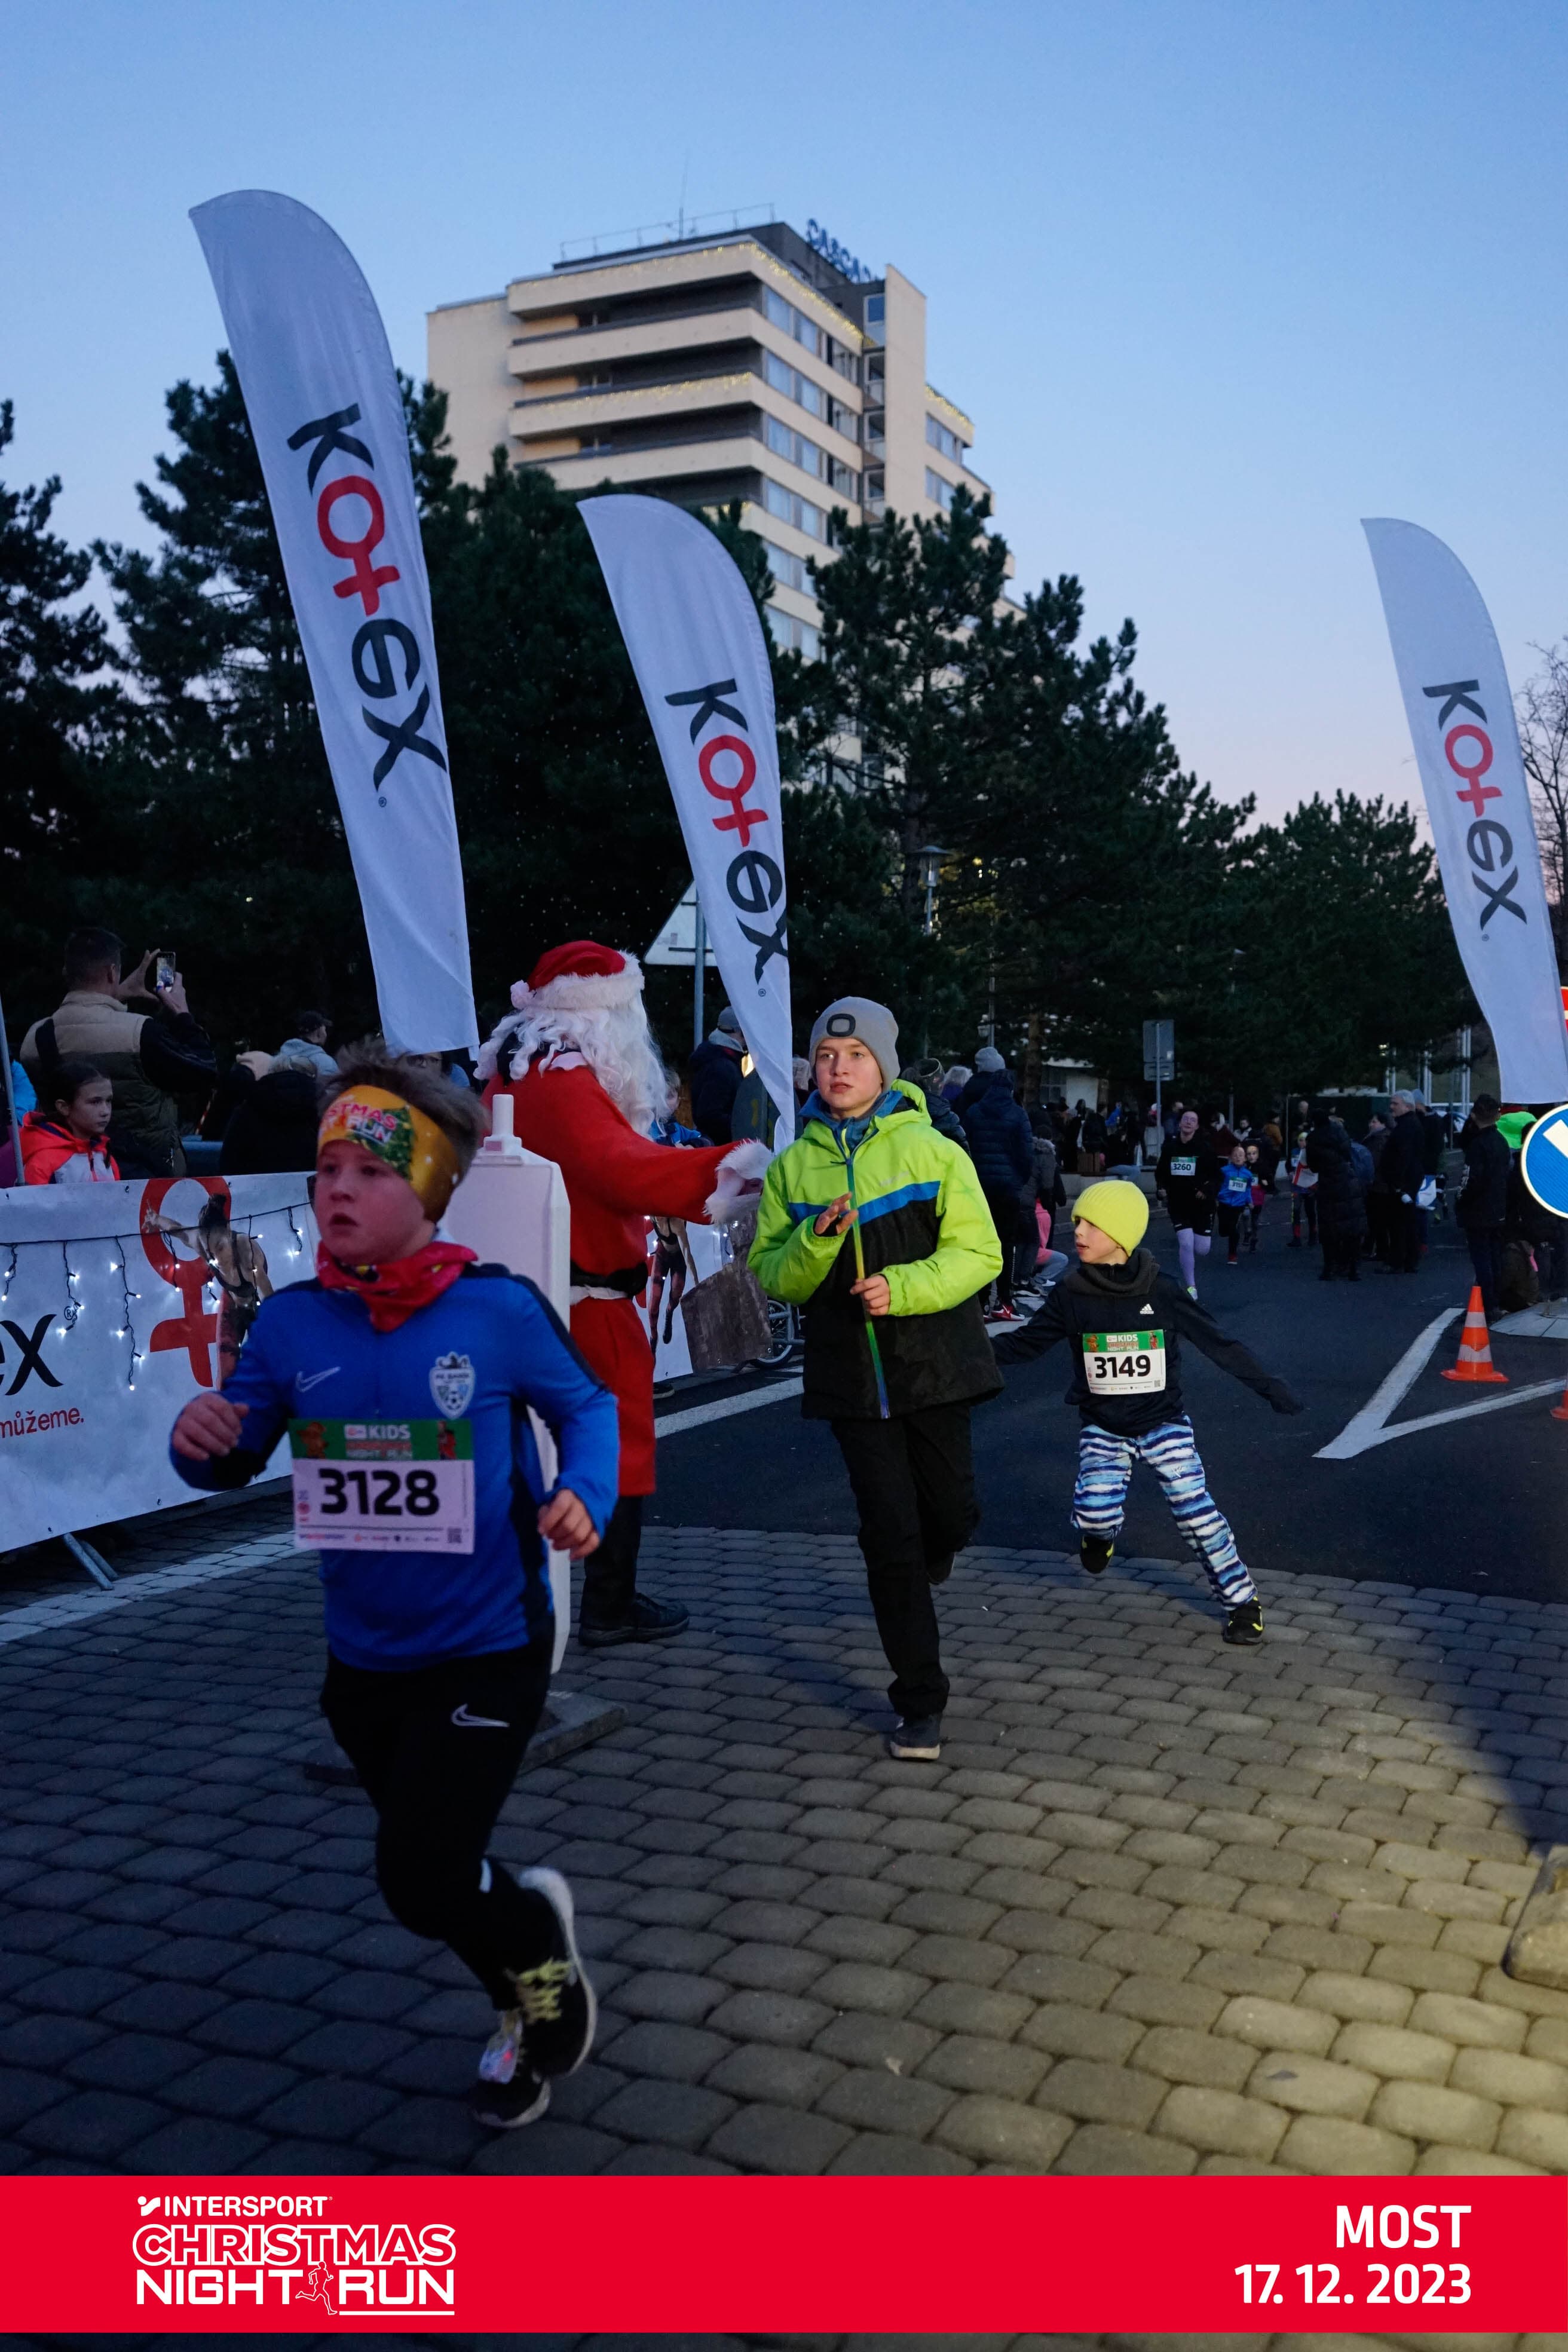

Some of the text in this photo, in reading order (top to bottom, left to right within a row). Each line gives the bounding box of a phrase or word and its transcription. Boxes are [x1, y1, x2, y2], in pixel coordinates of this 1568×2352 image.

[1118, 1333, 1138, 1342] KIDS
[1094, 1355, 1151, 1379] 3149
[368, 1423, 411, 1440] KIDS
[318, 1468, 440, 1517] 3128
